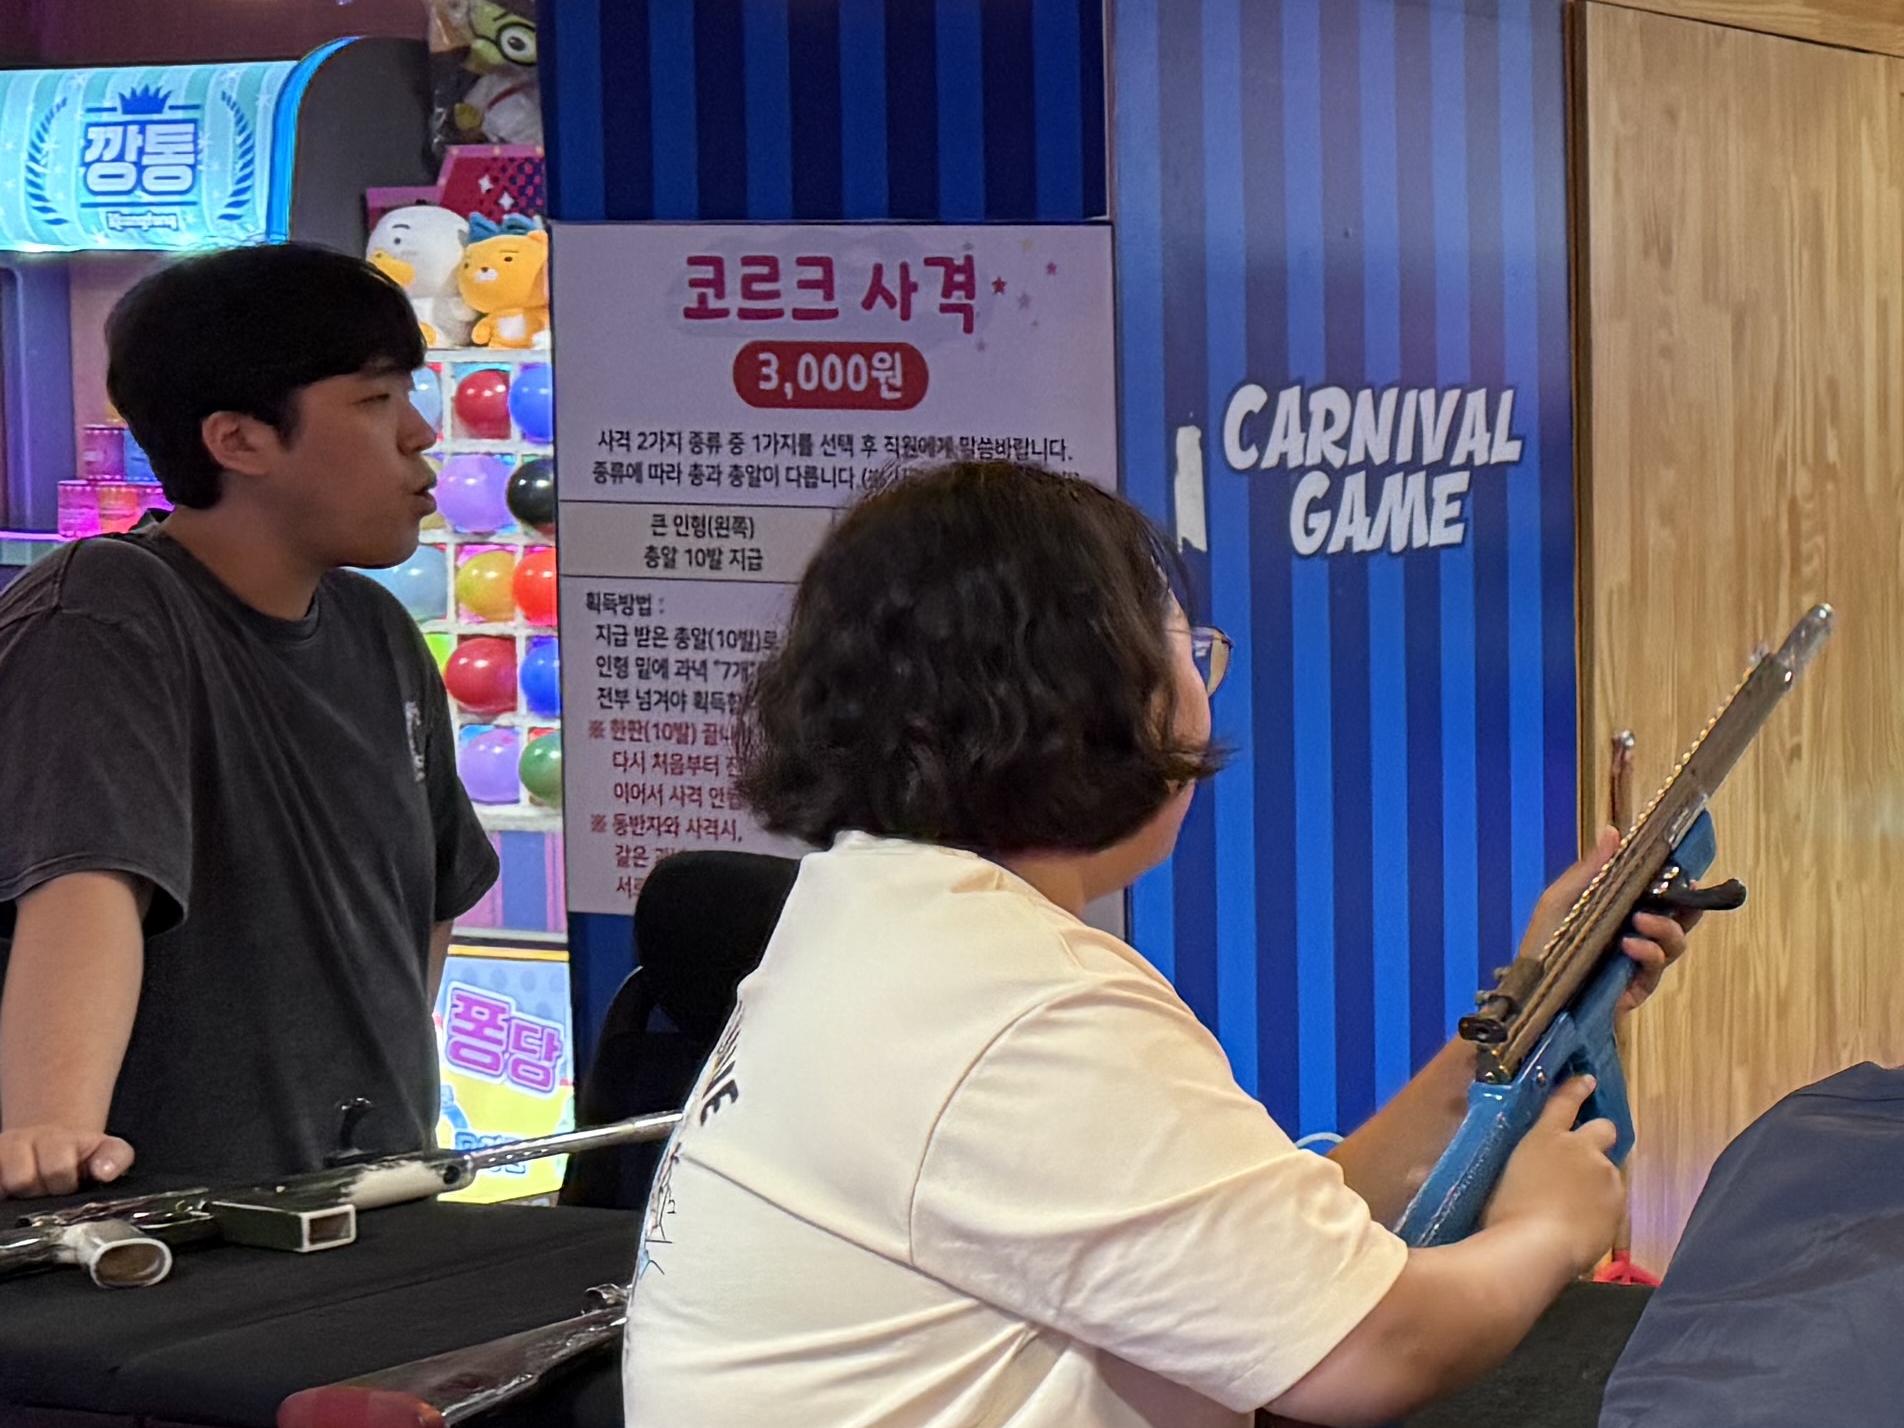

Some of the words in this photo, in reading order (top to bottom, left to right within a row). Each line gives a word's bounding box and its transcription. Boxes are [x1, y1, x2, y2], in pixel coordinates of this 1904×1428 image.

[84, 123, 196, 193] 깡통
[683, 255, 839, 320] 코르크
[861, 254, 976, 334] 사격
[757, 351, 904, 401] 3,000원
[1222, 383, 1523, 470] CARNIVAL
[598, 429, 631, 452] 사격
[637, 431, 682, 454] 2가지
[688, 432, 723, 456] 종류
[728, 432, 746, 456] 중
[752, 433, 814, 458] 1가지를
[821, 434, 854, 458] 선택
[861, 435, 878, 458] 후
[592, 461, 643, 485] 종류에
[648, 461, 682, 485] 따라
[687, 463, 722, 487] 총과
[728, 463, 780, 489] 총알이
[1289, 470, 1471, 556] GAME
[651, 514, 668, 537] 큰
[673, 515, 755, 540] 인형(왼쪽)
[644, 545, 679, 570] 총알
[685, 546, 724, 570] 10발
[729, 547, 764, 571] 지급
[596, 624, 629, 648] 지급
[635, 625, 670, 650] 받은
[596, 655, 630, 680] 인형
[636, 656, 670, 680] 밑에
[675, 657, 708, 682] 과녁
[598, 686, 631, 712] 전부
[636, 687, 688, 714] 넘겨야
[611, 719, 698, 745] 한판(10발)
[613, 750, 646, 773] 다시
[653, 752, 720, 777] 처음부터
[614, 782, 664, 807] 이어서
[670, 784, 703, 808] 사격
[613, 813, 680, 837] 동반자와
[615, 844, 650, 869] 같은
[447, 985, 564, 1092] 퐁당
